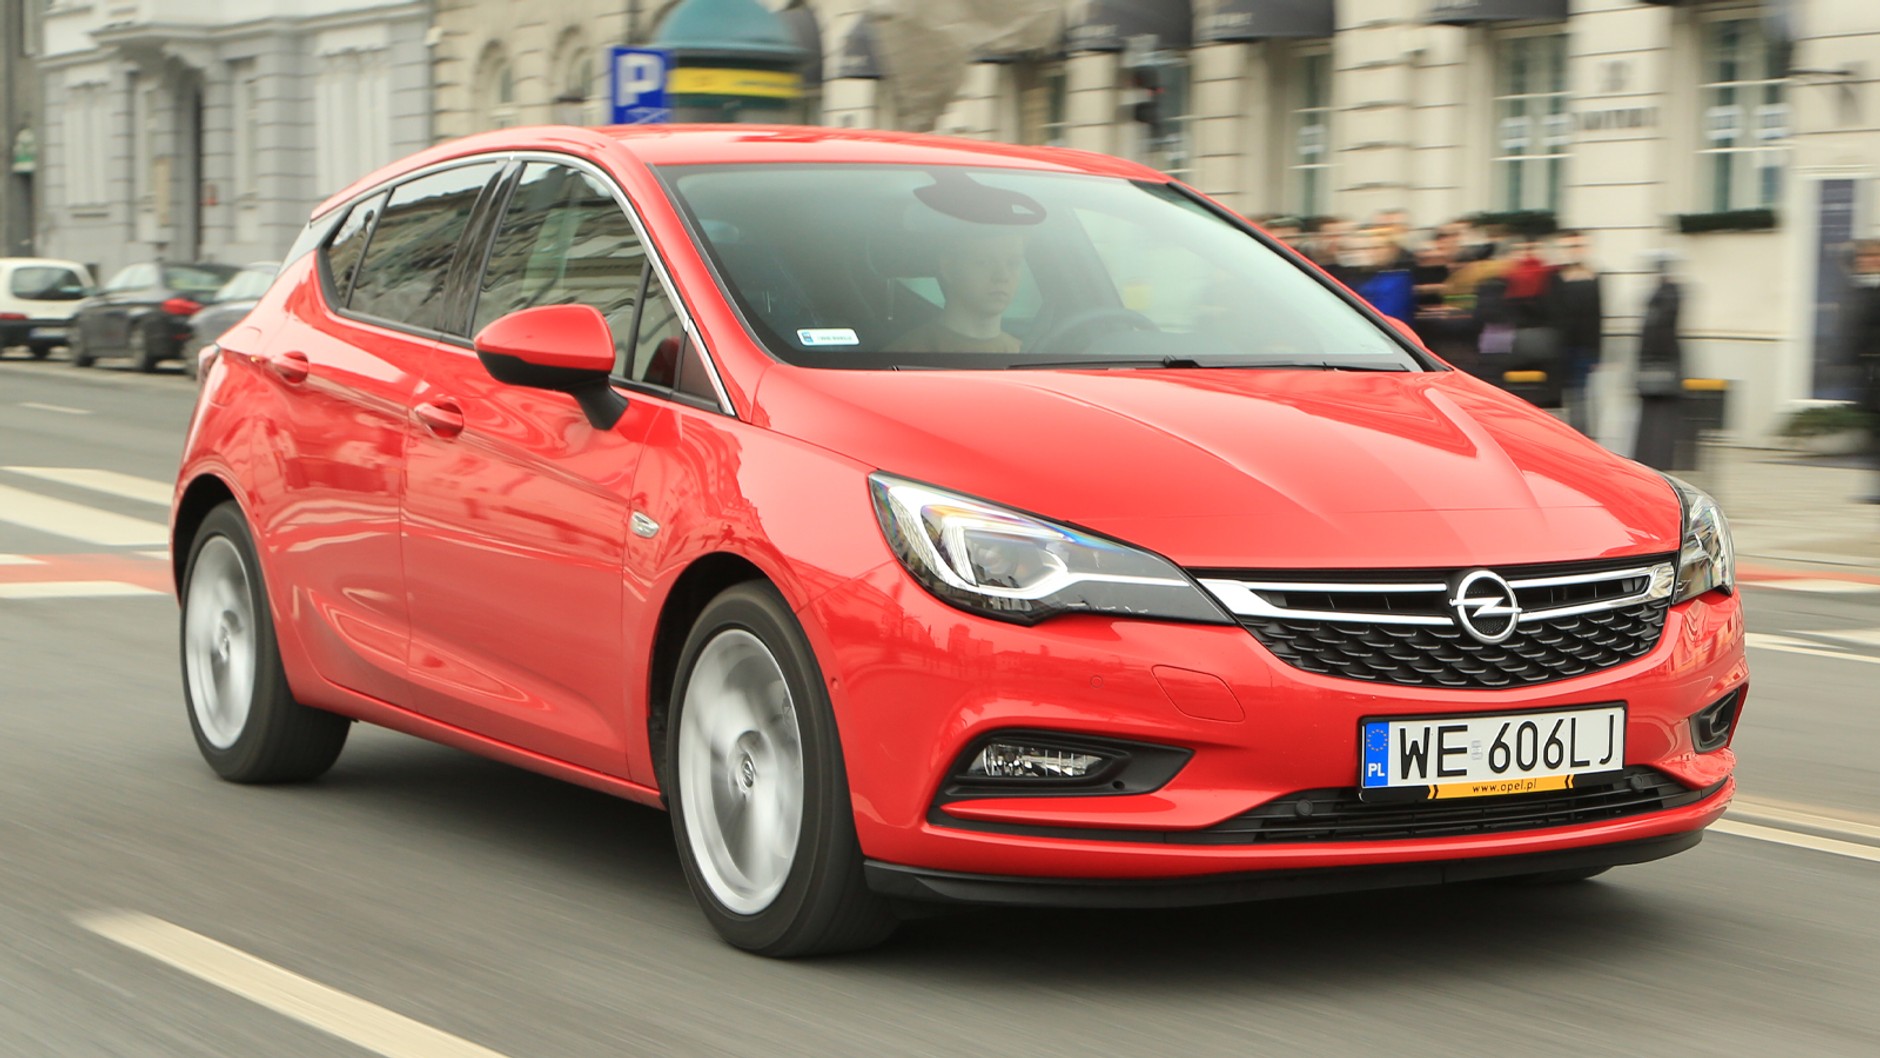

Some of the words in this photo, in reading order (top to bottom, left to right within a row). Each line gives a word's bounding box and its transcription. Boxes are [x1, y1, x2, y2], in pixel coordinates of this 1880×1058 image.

[616, 53, 665, 107] P
[1399, 725, 1467, 780] WE
[1488, 714, 1615, 774] 606LJ
[1368, 762, 1385, 777] PL
[1472, 778, 1536, 793] www.opel.pl
